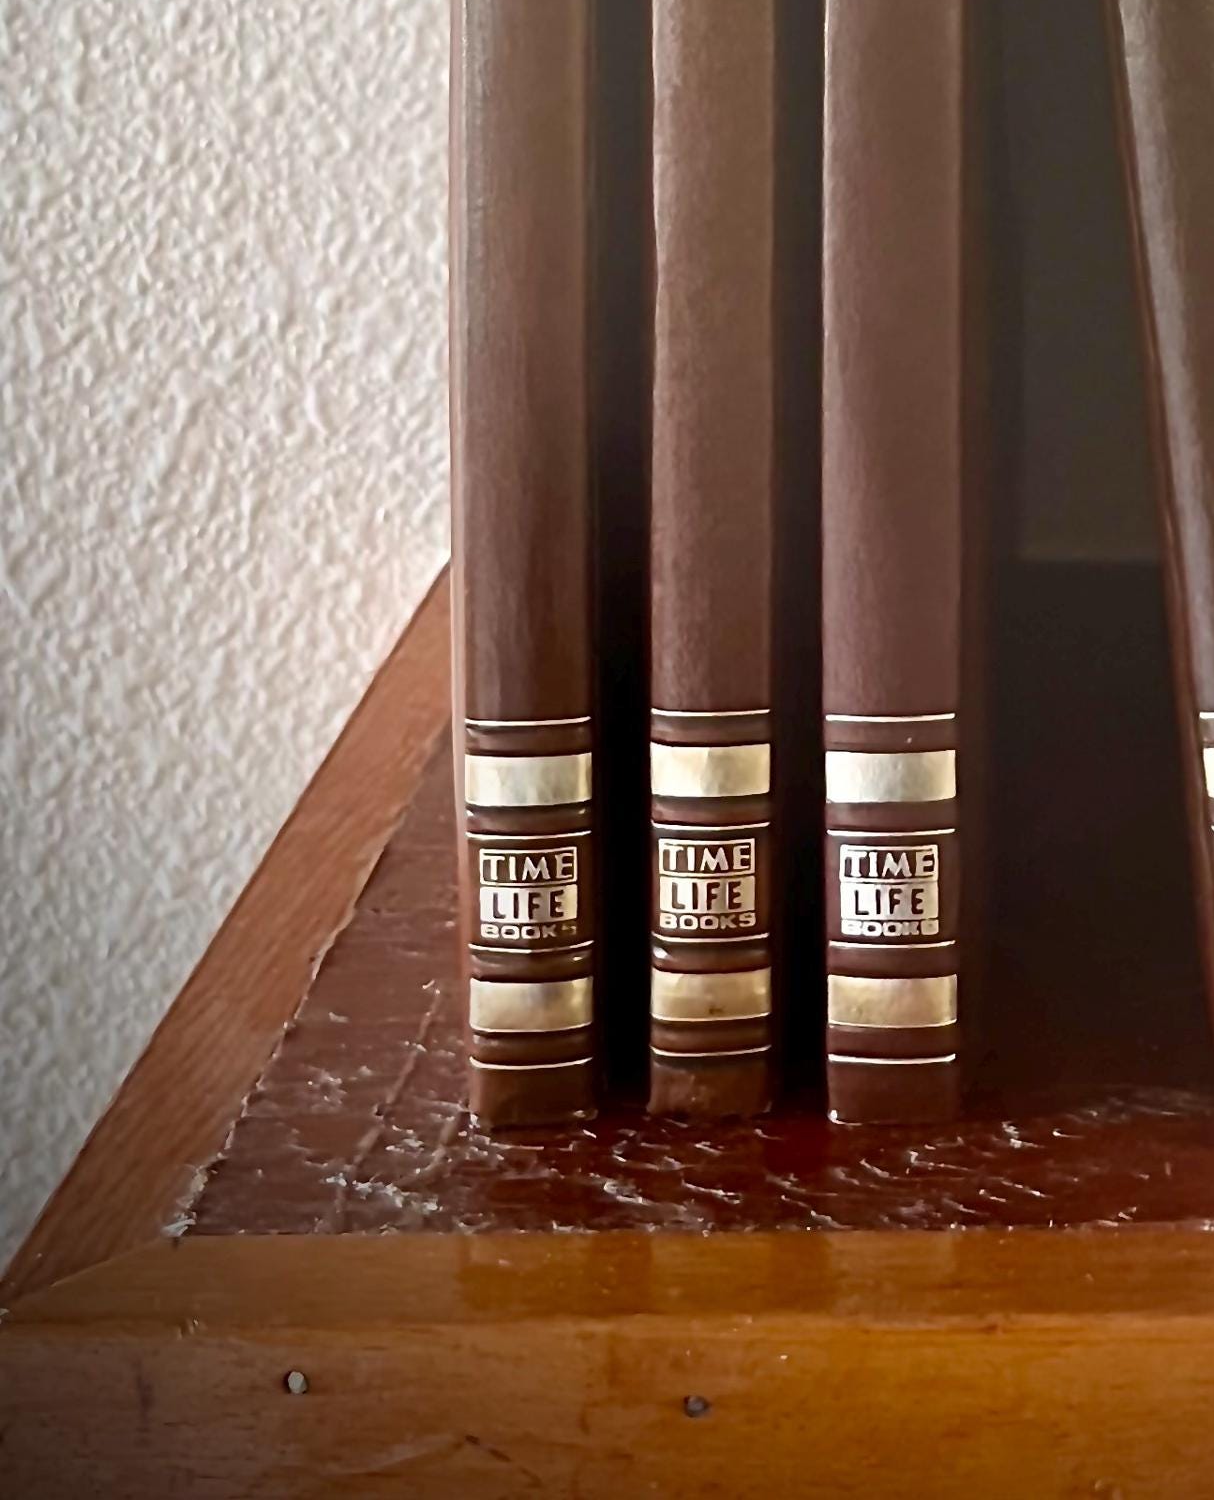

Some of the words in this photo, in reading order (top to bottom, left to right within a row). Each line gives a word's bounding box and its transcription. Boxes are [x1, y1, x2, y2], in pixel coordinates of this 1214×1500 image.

[483, 853, 574, 881] TIME
[662, 843, 752, 872] TIME
[844, 850, 935, 878] TIME
[491, 888, 565, 921] LIFE
[672, 880, 742, 911] LIFE
[855, 887, 924, 916] LIFE
[659, 912, 756, 930] BOOKS
